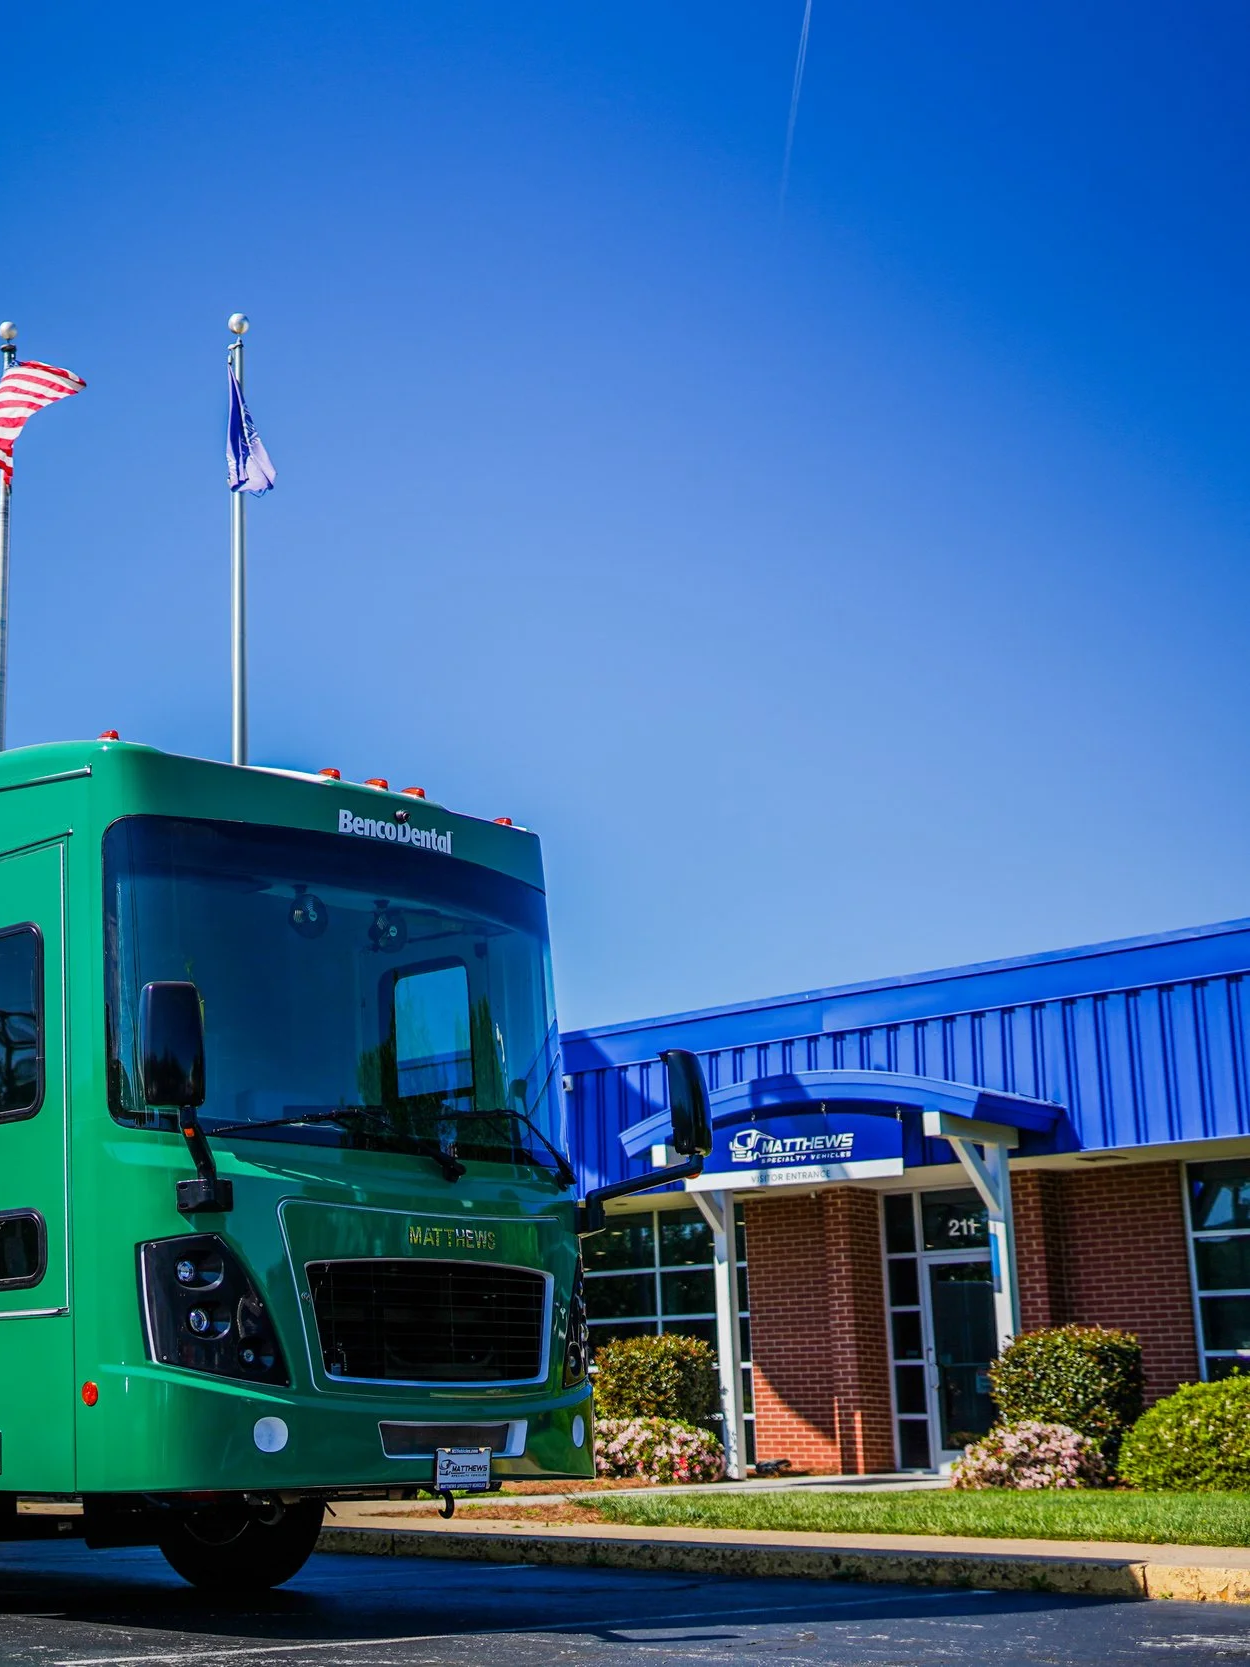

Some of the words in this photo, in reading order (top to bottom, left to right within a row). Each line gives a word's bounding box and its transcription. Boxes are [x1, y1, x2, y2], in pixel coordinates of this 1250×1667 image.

[338, 808, 452, 855] BencoDental
[761, 1133, 854, 1153] MATTHEWS
[761, 1154, 807, 1164] SPECIALTY
[810, 1150, 852, 1160] VEHICLES
[750, 1174, 784, 1184] VISITOR
[786, 1169, 831, 1181] ENTRANCE
[948, 1218, 976, 1236] 211
[409, 1226, 496, 1250] MATTHEWS
